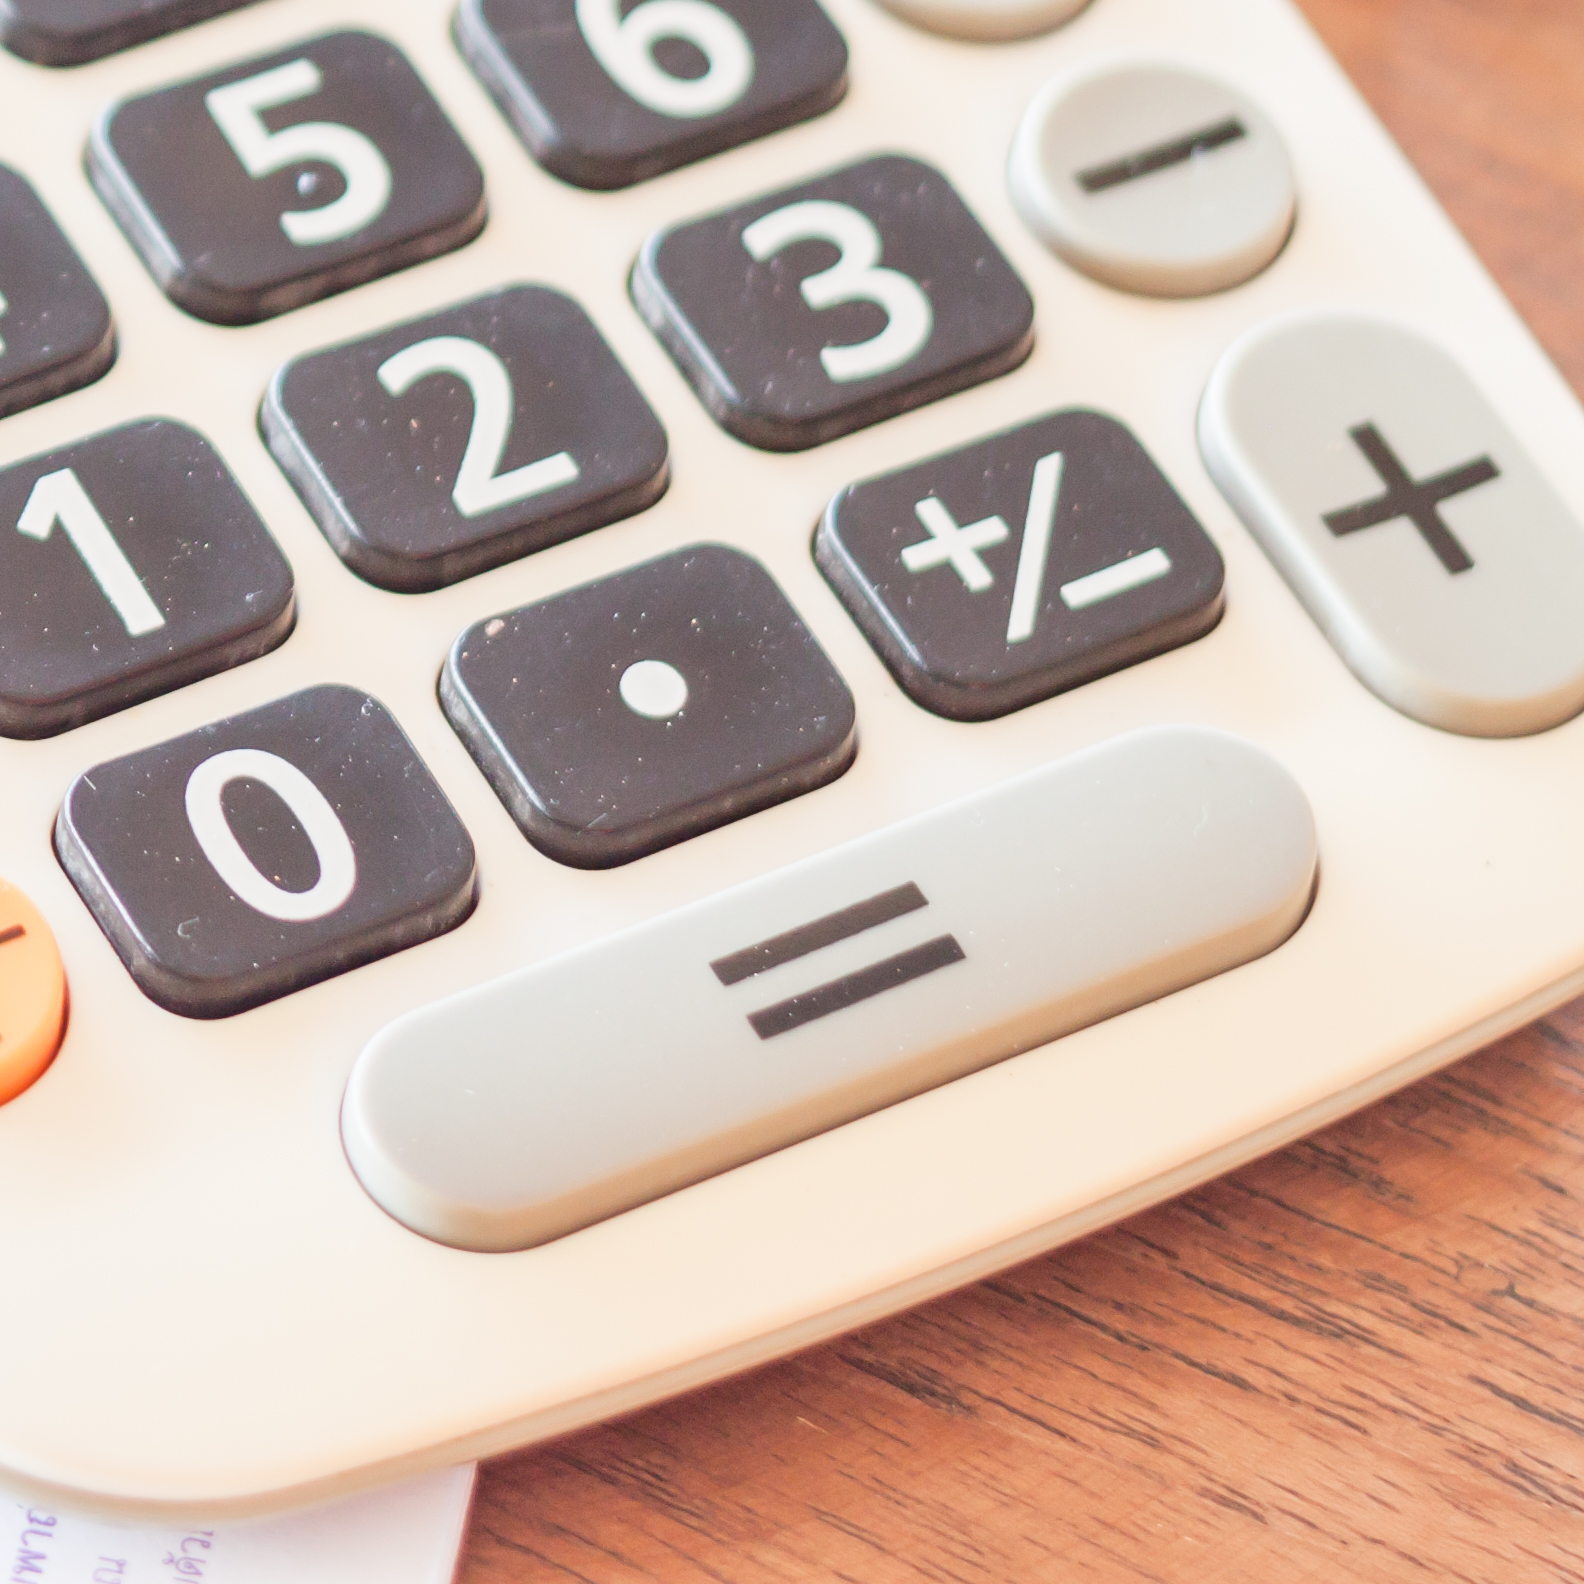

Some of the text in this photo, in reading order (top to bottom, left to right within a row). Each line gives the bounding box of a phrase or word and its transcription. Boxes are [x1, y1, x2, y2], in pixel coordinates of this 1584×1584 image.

[205, 58, 393, 246] 5
[741, 199, 936, 385] 3
[376, 334, 580, 519] 2
[14, 466, 167, 639] 1
[184, 746, 357, 922] 0
